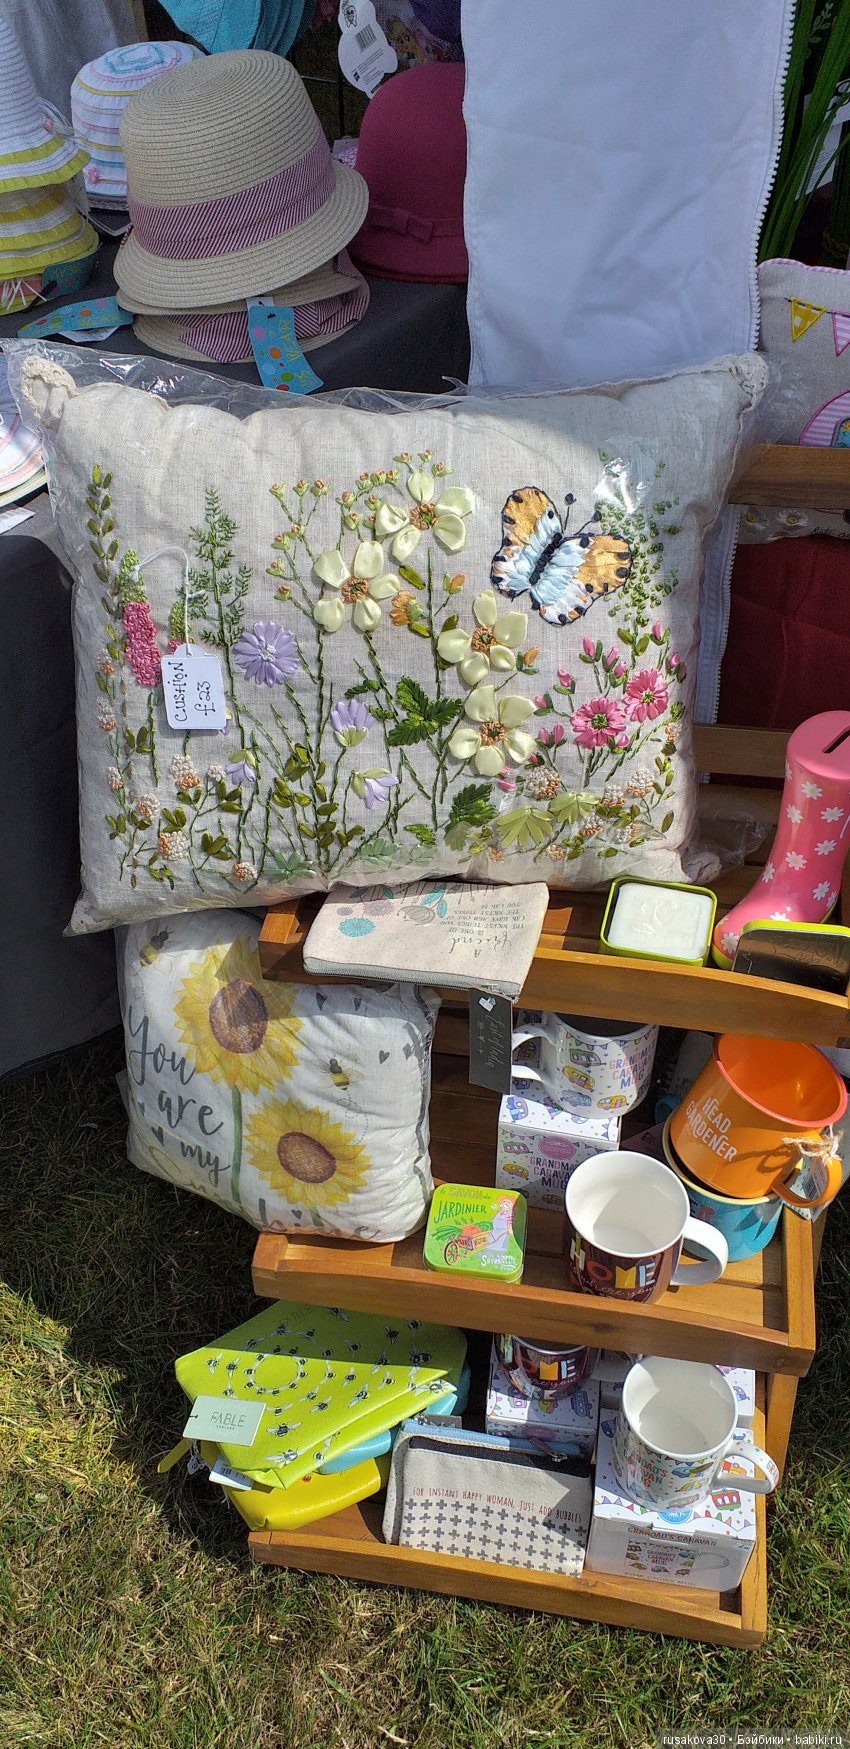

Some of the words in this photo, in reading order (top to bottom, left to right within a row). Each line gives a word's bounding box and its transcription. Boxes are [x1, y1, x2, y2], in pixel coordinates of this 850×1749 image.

[194, 681, 216, 716] £23
[127, 1005, 196, 1086] You
[157, 1089, 223, 1135] are
[702, 1097, 731, 1133] HEAD
[686, 1100, 737, 1163] GARDENER
[180, 1141, 231, 1188] my
[434, 1201, 487, 1224] JARDINIER
[569, 1237, 656, 1290] HOME
[211, 1411, 247, 1428] FABLE
[412, 1487, 424, 1497] FOR
[429, 1487, 458, 1499] INSTANT
[462, 1491, 482, 1501] HAPPY
[520, 1500, 534, 1512] JUST
[539, 1505, 552, 1517] ADD
[556, 1509, 582, 1523] BUBBLES
[677, 1534, 717, 1547] CARAVAN
